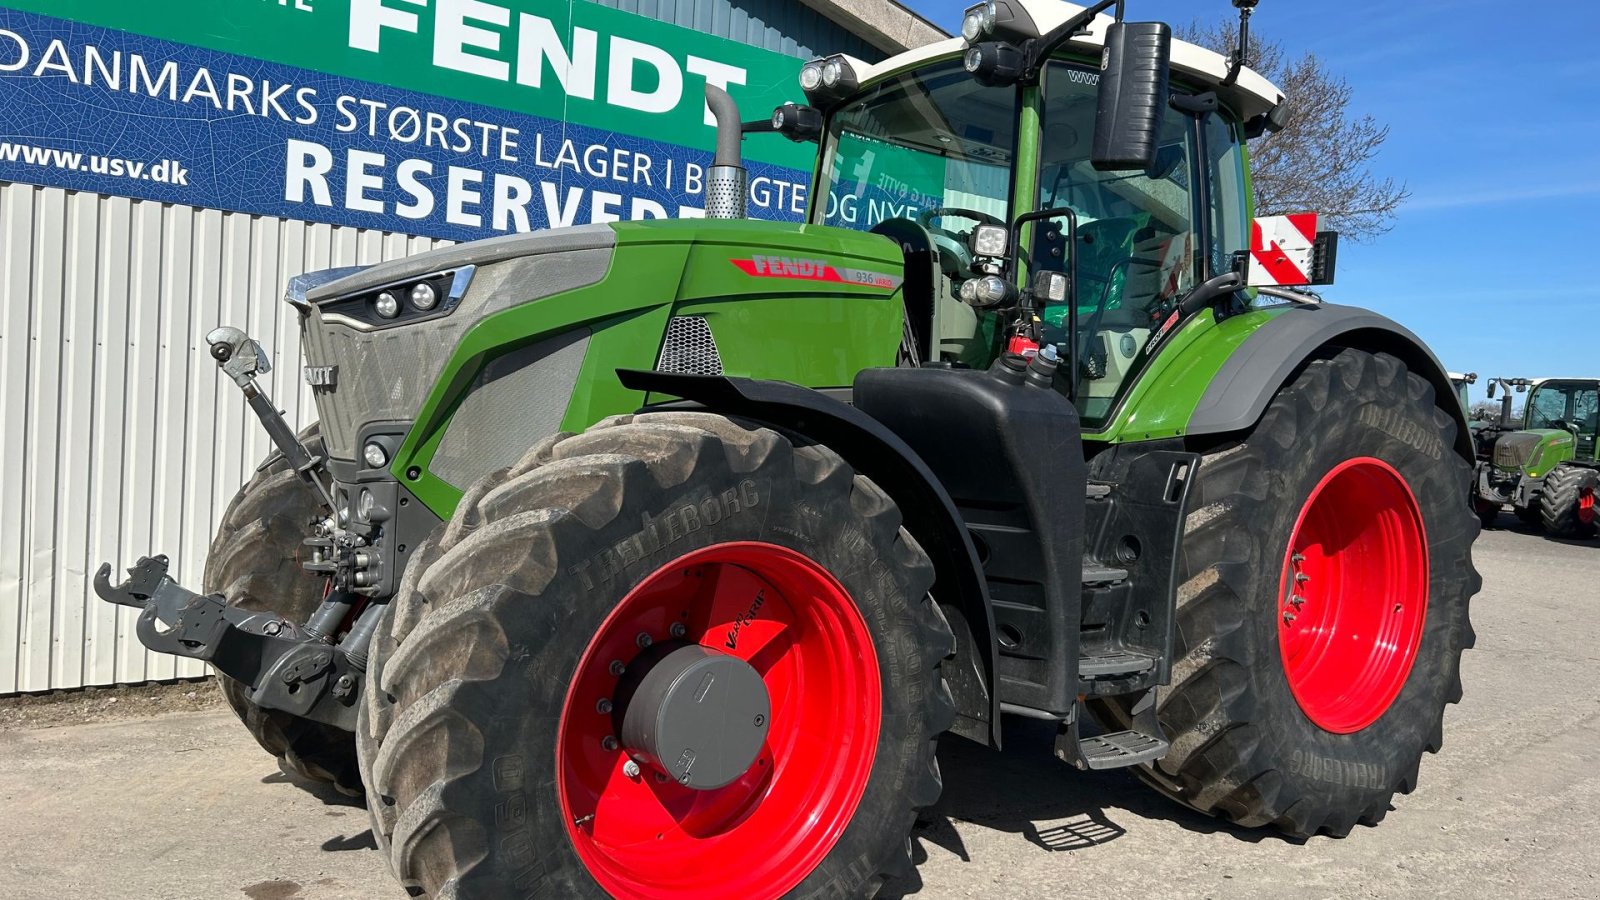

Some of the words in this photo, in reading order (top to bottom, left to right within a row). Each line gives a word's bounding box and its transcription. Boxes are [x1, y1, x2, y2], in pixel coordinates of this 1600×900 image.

[348, 0, 747, 127] FENDT
[0, 28, 317, 125] DANMARKS
[336, 95, 520, 163] STØRSTE
[534, 133, 652, 189] LAGER
[664, 158, 673, 190] I
[685, 164, 806, 213] BGTE
[0, 142, 188, 185] www.usv.dk
[752, 254, 827, 278] FENDT
[856, 271, 873, 284] 936
[874, 277, 893, 287] VARIO
[567, 478, 760, 593] TRELLEBORG
